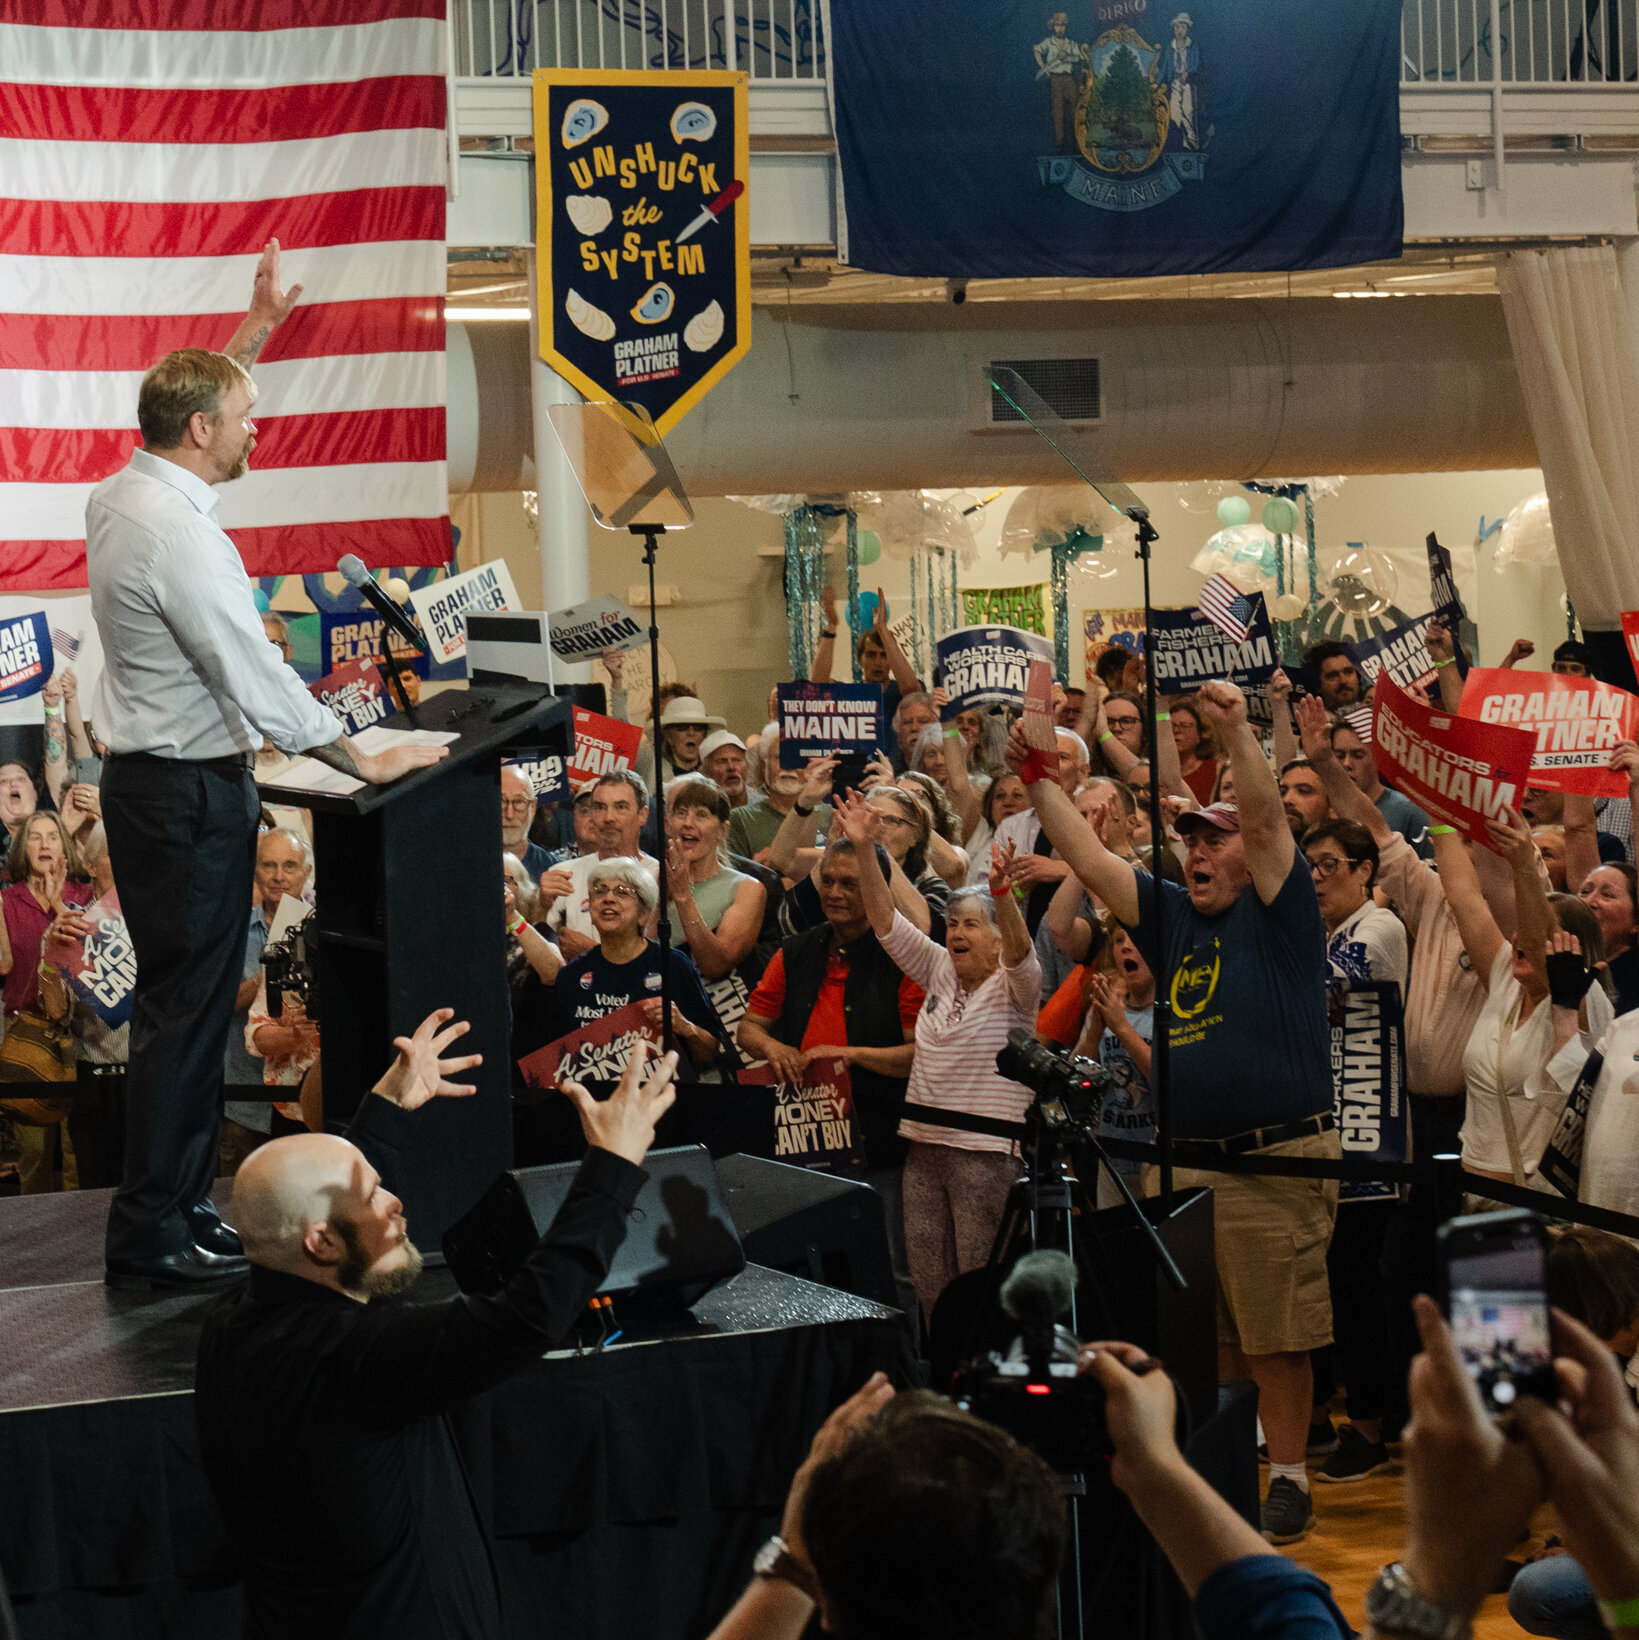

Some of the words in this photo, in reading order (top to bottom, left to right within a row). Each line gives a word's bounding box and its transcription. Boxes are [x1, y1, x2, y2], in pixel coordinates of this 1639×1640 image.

[568, 141, 720, 194] UNSHUCK
[621, 197, 663, 226] the
[579, 232, 705, 280] SYSTEM
[613, 332, 678, 360] GRAHAM
[615, 350, 679, 377] PLATNER
[428, 566, 498, 625] GRAHAM
[963, 584, 1043, 614] GRAHAM
[549, 620, 599, 640] Women
[600, 611, 620, 626] for
[550, 616, 643, 655] GRAHAM
[943, 645, 1001, 666] HEALTH
[947, 654, 1027, 673] WORKERS
[1154, 636, 1273, 678] GRAHAM
[321, 678, 367, 707] Senator
[331, 683, 376, 718] NEY
[783, 700, 804, 713] THEY
[805, 700, 836, 713] DON'T
[837, 700, 877, 714] KNOW
[1480, 690, 1625, 723] GRAHAM
[351, 696, 387, 730] BUY
[784, 715, 877, 740] MAINE
[1381, 701, 1491, 776] EDUCATORS
[1377, 712, 1516, 825] GRAHAM
[1544, 754, 1600, 766] SENATE
[575, 1006, 605, 1019] Most
[595, 993, 629, 1007] Voted
[553, 1052, 576, 1084] A
[579, 1026, 652, 1068] Senator
[1341, 991, 1382, 1152] GRAHAM
[791, 1082, 839, 1101] Senator
[775, 1122, 820, 1156] AN'T
[822, 1119, 853, 1151] BUY
